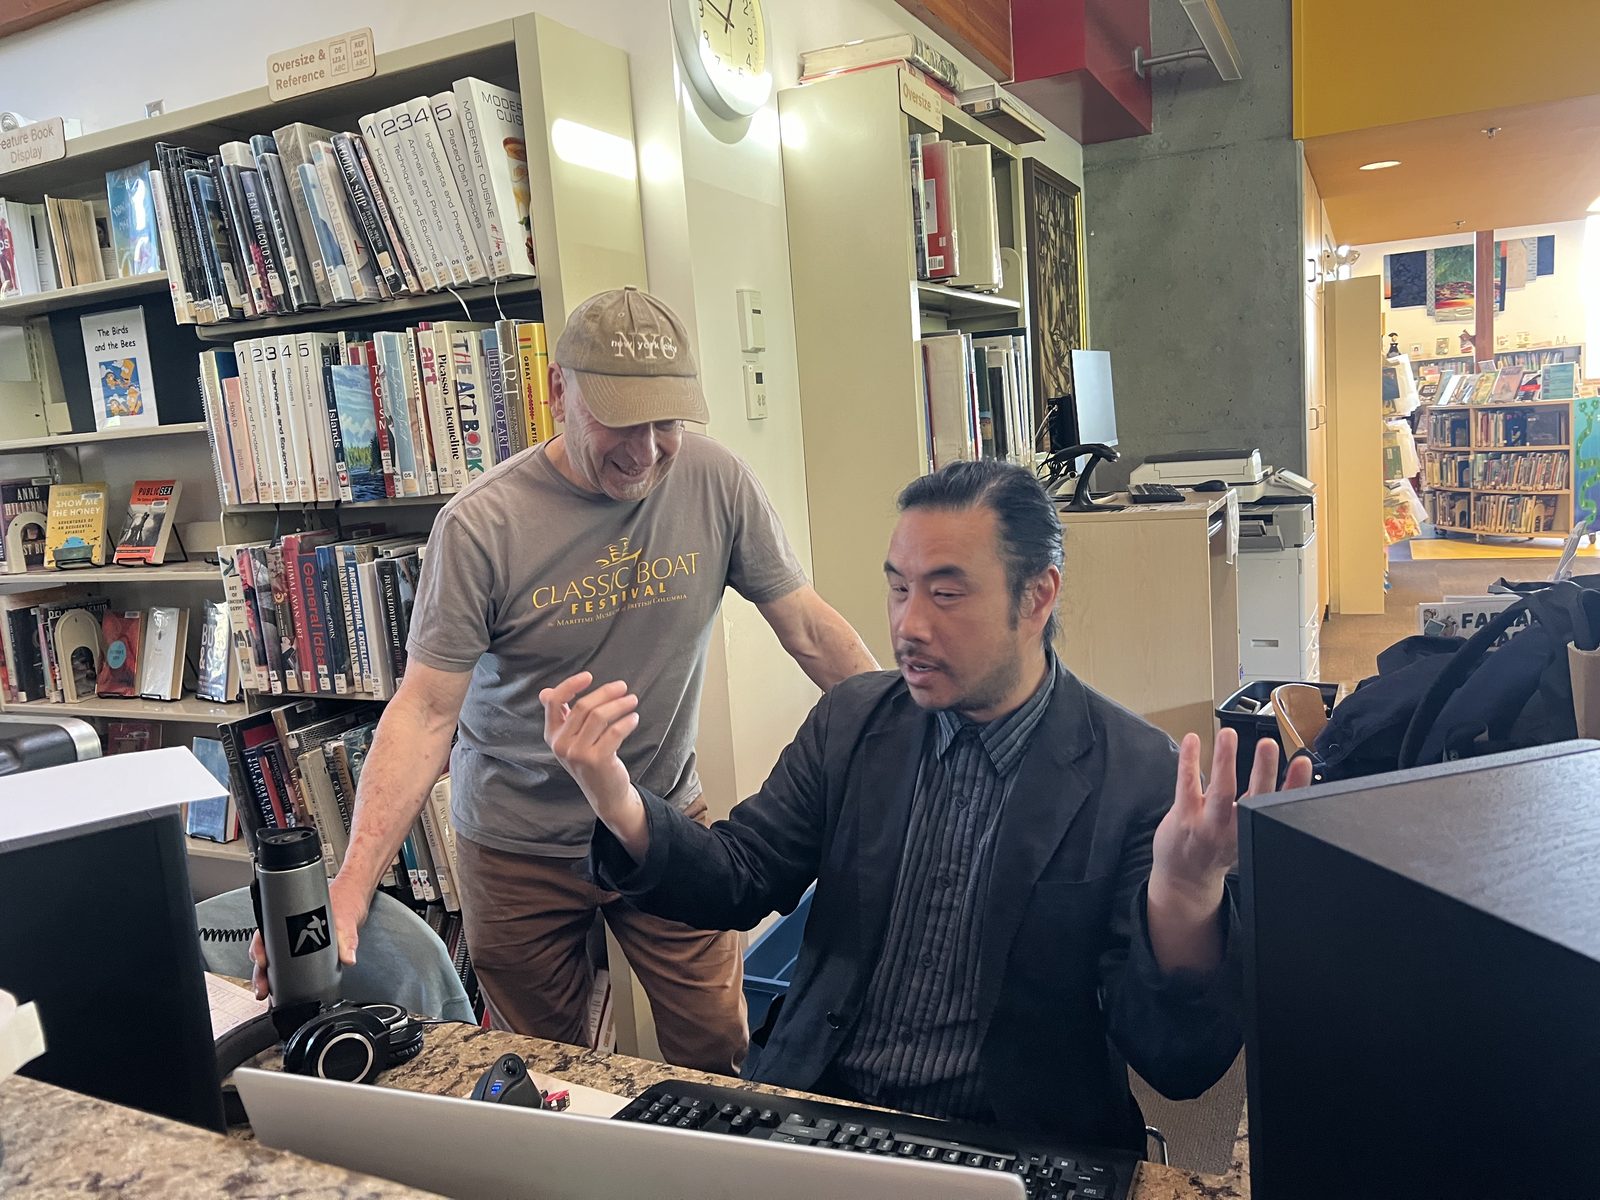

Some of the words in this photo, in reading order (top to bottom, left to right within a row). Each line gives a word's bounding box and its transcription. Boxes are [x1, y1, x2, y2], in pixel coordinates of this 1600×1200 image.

[354, 40, 364, 49] REF
[747, 27, 753, 45] 3
[272, 53, 315, 73] Oversize
[318, 48, 326, 61] &
[276, 69, 325, 90] Reference
[903, 82, 931, 112] Oversize
[396, 113, 413, 130] 3
[414, 108, 429, 123] 4
[435, 103, 452, 121] 5
[496, 109, 523, 126] CUIS
[0, 134, 29, 150] eature
[31, 124, 54, 141] Book
[366, 126, 376, 139] 1
[381, 119, 398, 137] 2
[10, 147, 42, 163] Display
[463, 100, 484, 171] MODERNIST
[480, 173, 495, 219] CUISINE
[337, 142, 357, 183] WOODEN
[352, 184, 368, 207] SHIP
[408, 139, 424, 177] Animals
[422, 180, 433, 198] and
[429, 200, 443, 231] Plants
[447, 129, 469, 187] Plated-Dish
[467, 188, 482, 229] Recipes
[393, 143, 416, 197] Techniques
[412, 199, 423, 217] and
[419, 218, 438, 262] Equipme
[424, 132, 447, 188] Ingredients
[444, 190, 455, 209] and
[451, 210, 471, 256] Preparat
[375, 148, 391, 183] History
[389, 187, 399, 204] and
[396, 206, 422, 267] Fundamental
[246, 192, 262, 231] BENEATH
[257, 232, 268, 256] COLD
[264, 256, 275, 273] SEA
[97, 328, 110, 337] The
[111, 325, 129, 336] Birds
[94, 342, 106, 352] and
[107, 341, 119, 350] the
[120, 339, 136, 348] Bees
[239, 351, 246, 364] 1
[252, 348, 264, 363] 2
[266, 346, 277, 360] 3
[281, 345, 292, 359] 4
[298, 343, 310, 357] 5
[453, 336, 472, 375] THE
[611, 340, 632, 348] new
[637, 340, 660, 350] york
[615, 331, 676, 360] NYC
[421, 347, 437, 386] art
[500, 351, 520, 400] ART
[243, 372, 251, 404] History
[271, 369, 281, 416] Techniques
[490, 361, 504, 406] HISTORY
[437, 354, 449, 395] Picasso
[444, 406, 460, 460] Jacqueline
[458, 381, 477, 415] ART
[233, 420, 238, 428] to
[328, 408, 342, 448] Islands
[496, 409, 505, 425] OF
[463, 420, 485, 472] BOOK
[498, 428, 509, 447] ART
[17, 487, 40, 500] ANNE
[55, 500, 82, 508] SHOW
[160, 487, 173, 495] SEX
[70, 508, 101, 516] HONEY
[384, 575, 392, 598] FRANK
[532, 567, 629, 609] CLASSIC
[637, 552, 700, 584] BOAT
[285, 561, 300, 618] HIMALAYAN
[295, 622, 303, 639] ART
[387, 598, 396, 621] LLOYD
[556, 617, 594, 627] MARITIME
[652, 594, 688, 604] COLUMBIA
[571, 582, 667, 615] FESTIVAL
[303, 562, 319, 629] General
[312, 632, 326, 665] Idea
[348, 566, 363, 629] ARCHITECTURAL
[358, 631, 369, 673] EXCELLENC
[391, 621, 400, 647] WRIGHT
[252, 757, 262, 773] THE
[258, 777, 272, 810] WORLD
